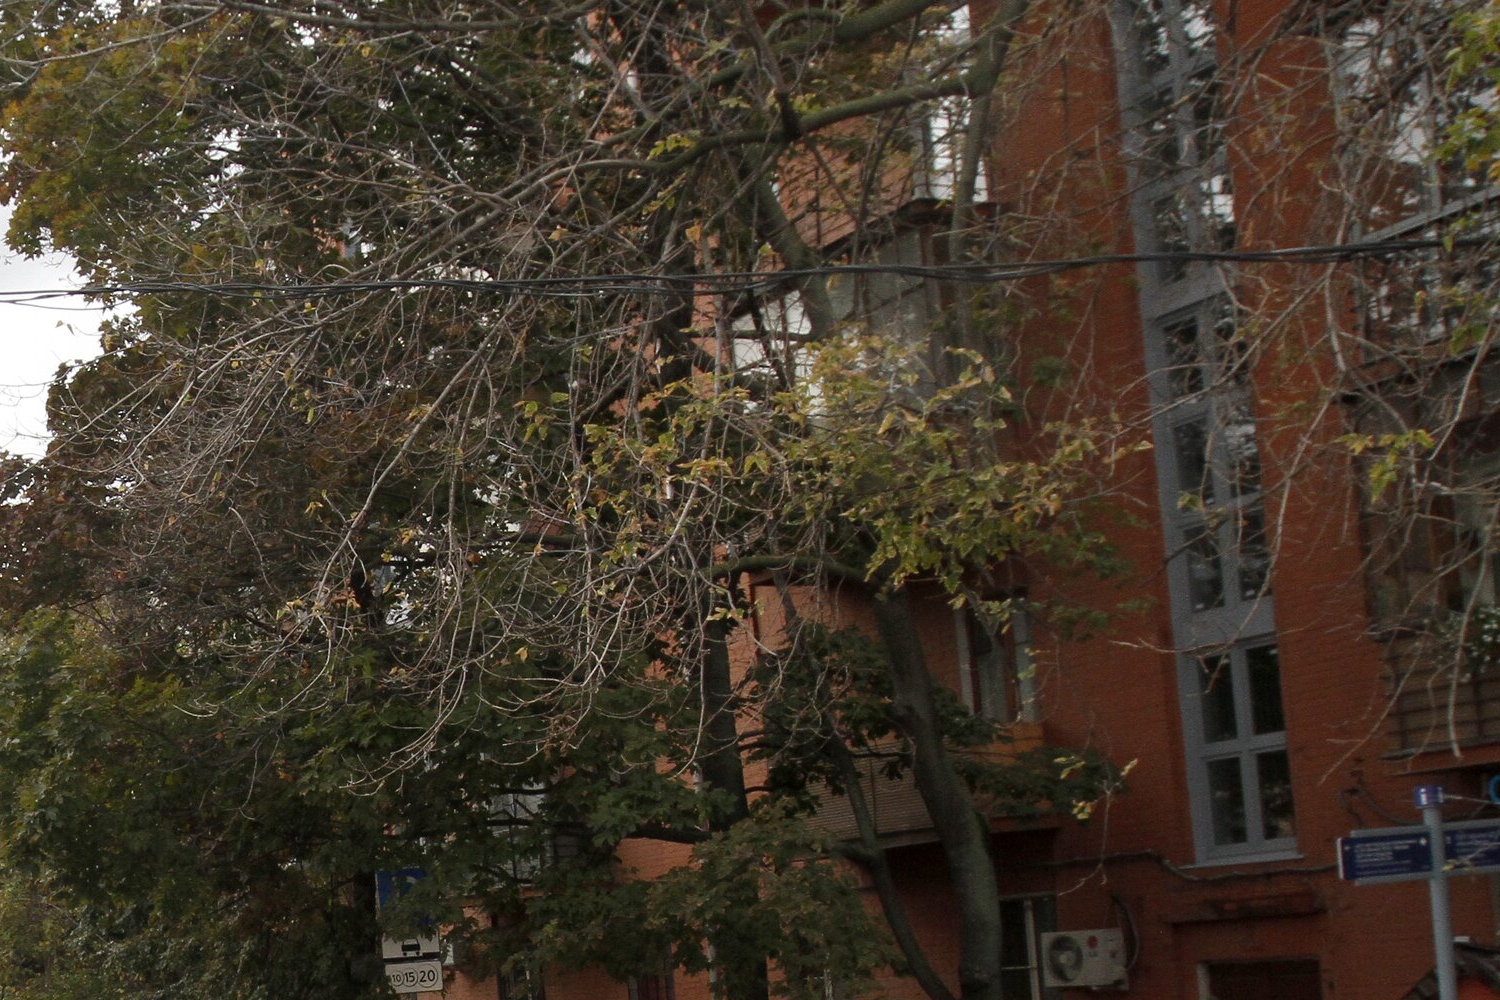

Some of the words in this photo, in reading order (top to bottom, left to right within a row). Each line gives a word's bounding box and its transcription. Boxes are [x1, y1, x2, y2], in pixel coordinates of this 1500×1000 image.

[392, 974, 402, 982] 10
[405, 971, 415, 982] 15
[420, 970, 435, 982] 20
